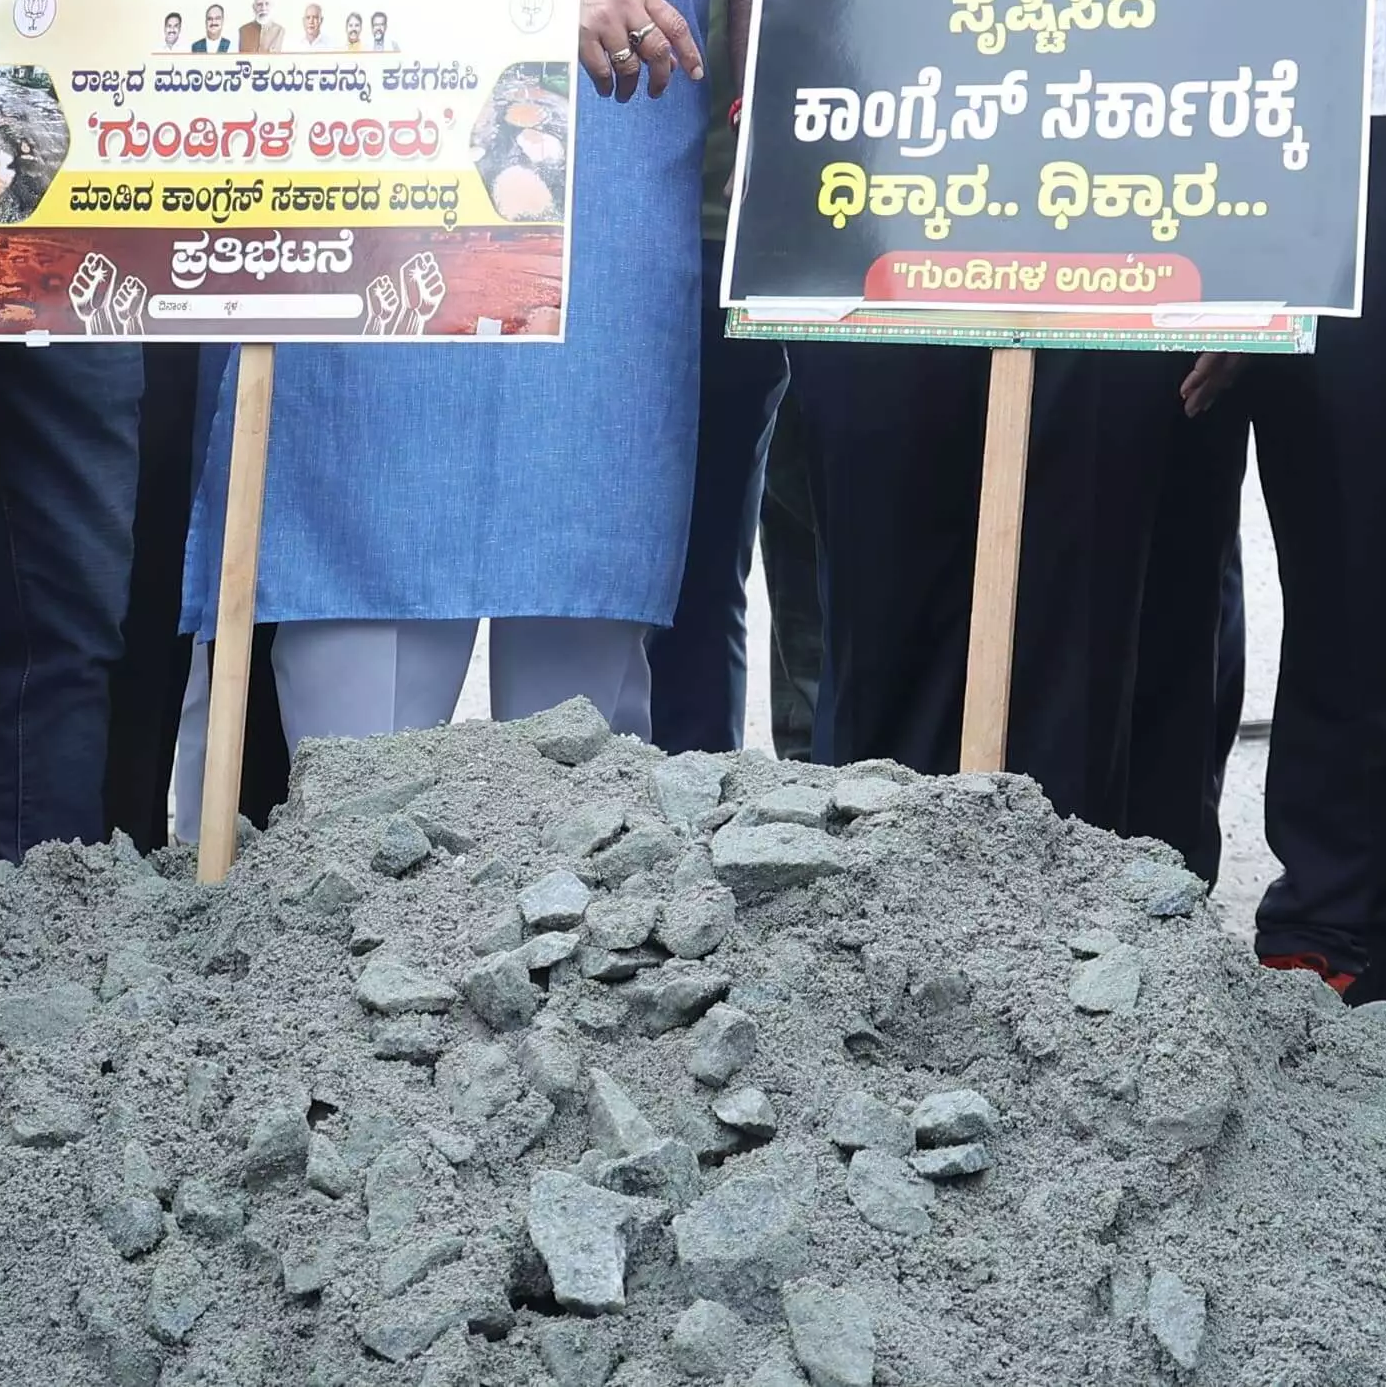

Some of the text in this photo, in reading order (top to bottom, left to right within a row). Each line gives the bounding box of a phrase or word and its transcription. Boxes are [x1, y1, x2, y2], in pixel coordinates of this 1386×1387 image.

[71, 60, 479, 105] ರಾಜ್ಯದ ಮೂಲಸೌಕರ್ಯವನ್ನು ಕಡೆಗಣಿಸಿ
[793, 59, 1311, 170] ಕಾಂಗ್ರೆಸ್ ಸರ್ಕಾರಕ್ಕೆ
[69, 179, 461, 230] ಮಾಡಿದ ಕಾಂಗ್ರೆಸ್ ಸರ್ಕಾರದ ವಿರುದ್ಧ
[817, 161, 1268, 242] ಧಿಕ್ಕಾರ.. ಧಿಕ್ಕಾರ...
[170, 229, 355, 289] ಪ್ರತಿಭಟನೆ
[893, 258, 1173, 293] "ಗುಂಡಿಗಳ ಊರು"
